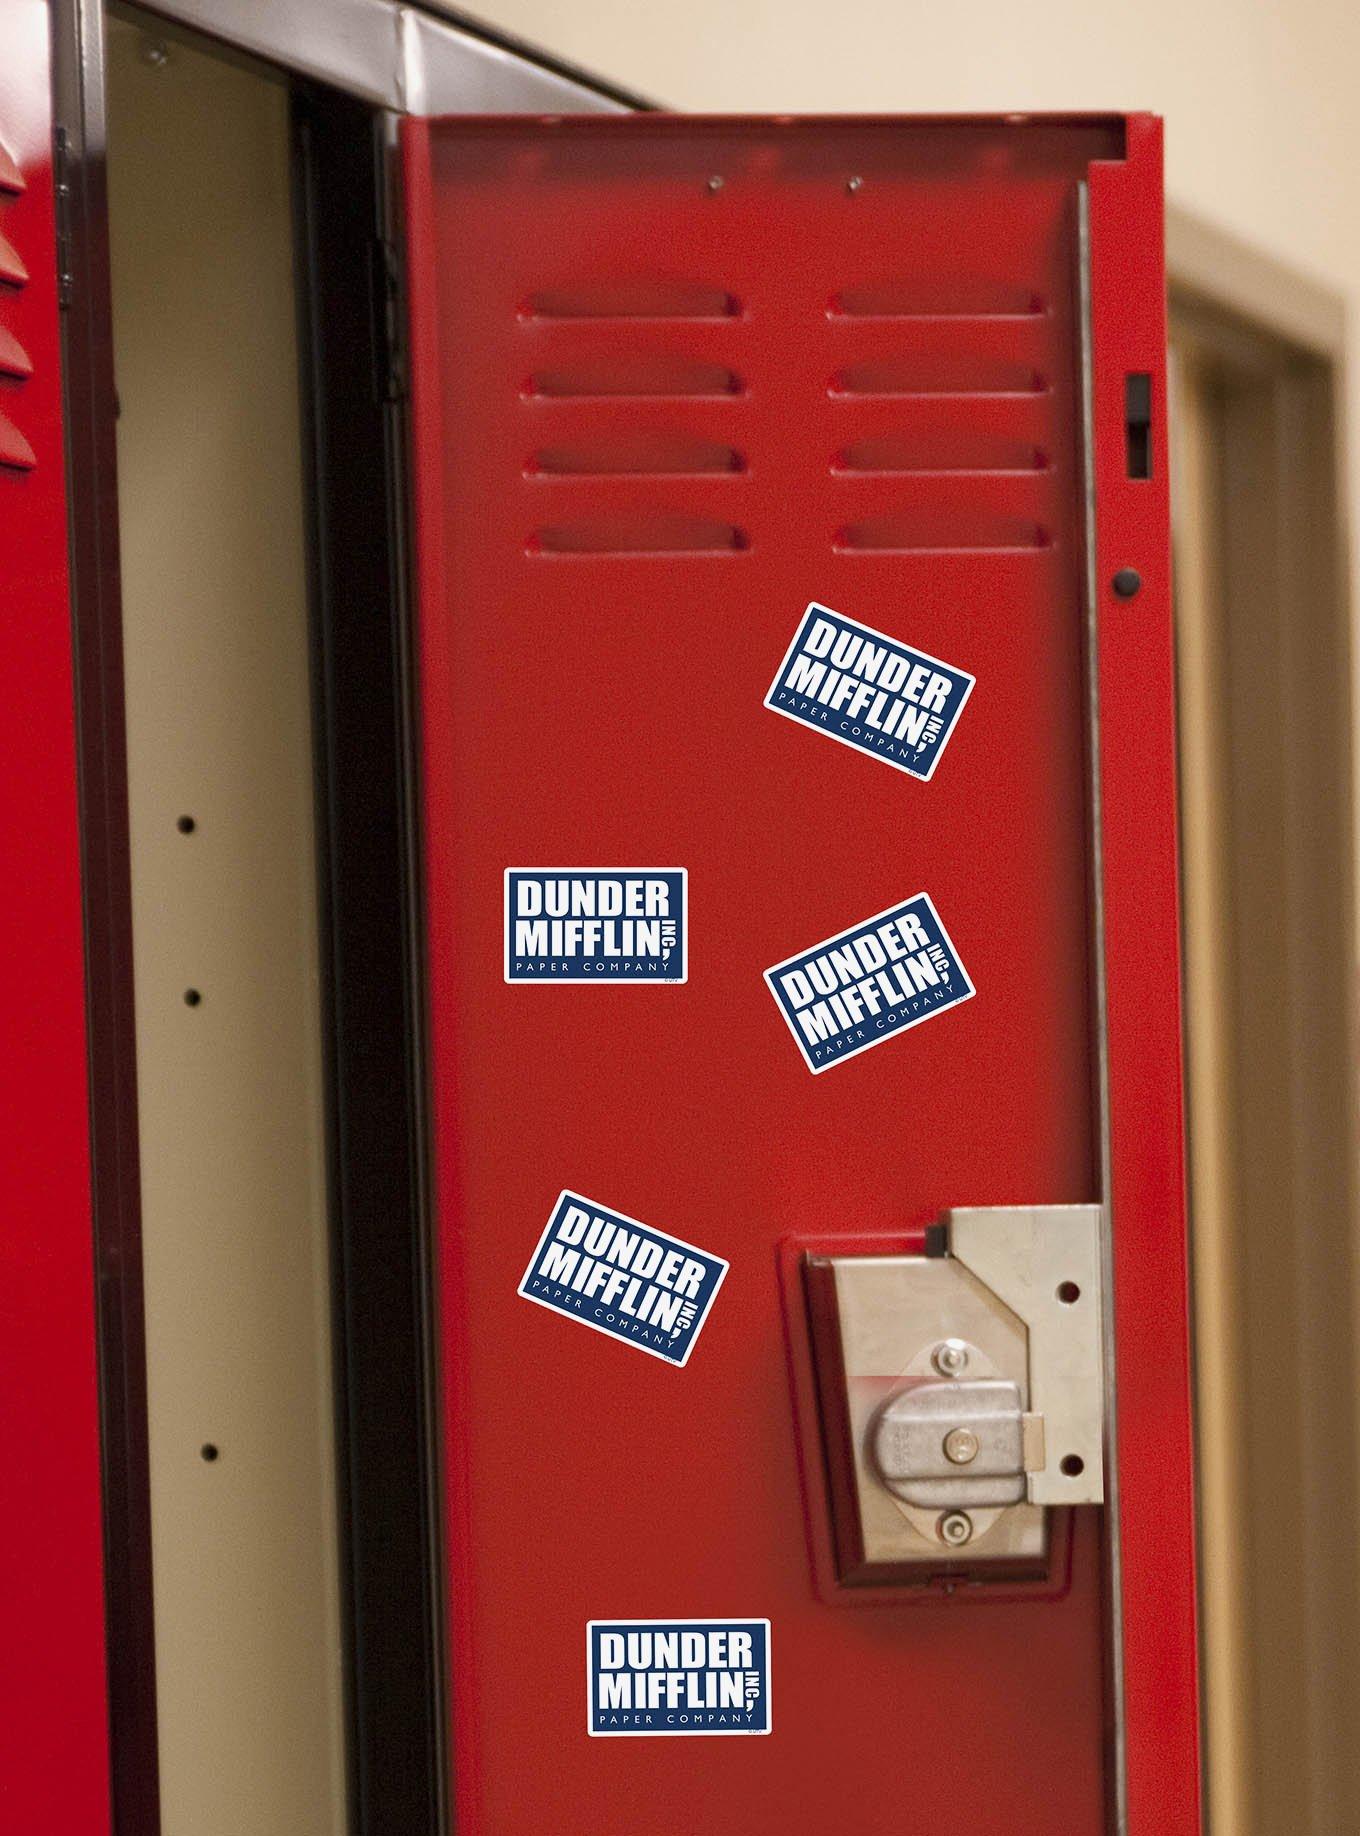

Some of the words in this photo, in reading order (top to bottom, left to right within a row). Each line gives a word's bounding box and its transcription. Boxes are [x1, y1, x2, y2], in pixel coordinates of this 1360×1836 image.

[803, 618, 952, 714] DUNDER
[779, 693, 827, 720] PAPER
[840, 722, 919, 762] COMPANY
[518, 880, 669, 917] DUNDER
[516, 963, 568, 971] PAPER
[583, 963, 668, 971] COMPANY
[780, 913, 930, 1010] DUNDER
[816, 1030, 864, 1059] PAPER
[876, 985, 952, 1028] COMPANY
[556, 1205, 706, 1299] DUNDER
[533, 1280, 581, 1308] PAPER
[595, 1309, 674, 1348] COMPANY
[600, 1632, 752, 1669] DUNDER
[600, 1715, 652, 1723] PAPER
[667, 1714, 752, 1723] COMPANY
